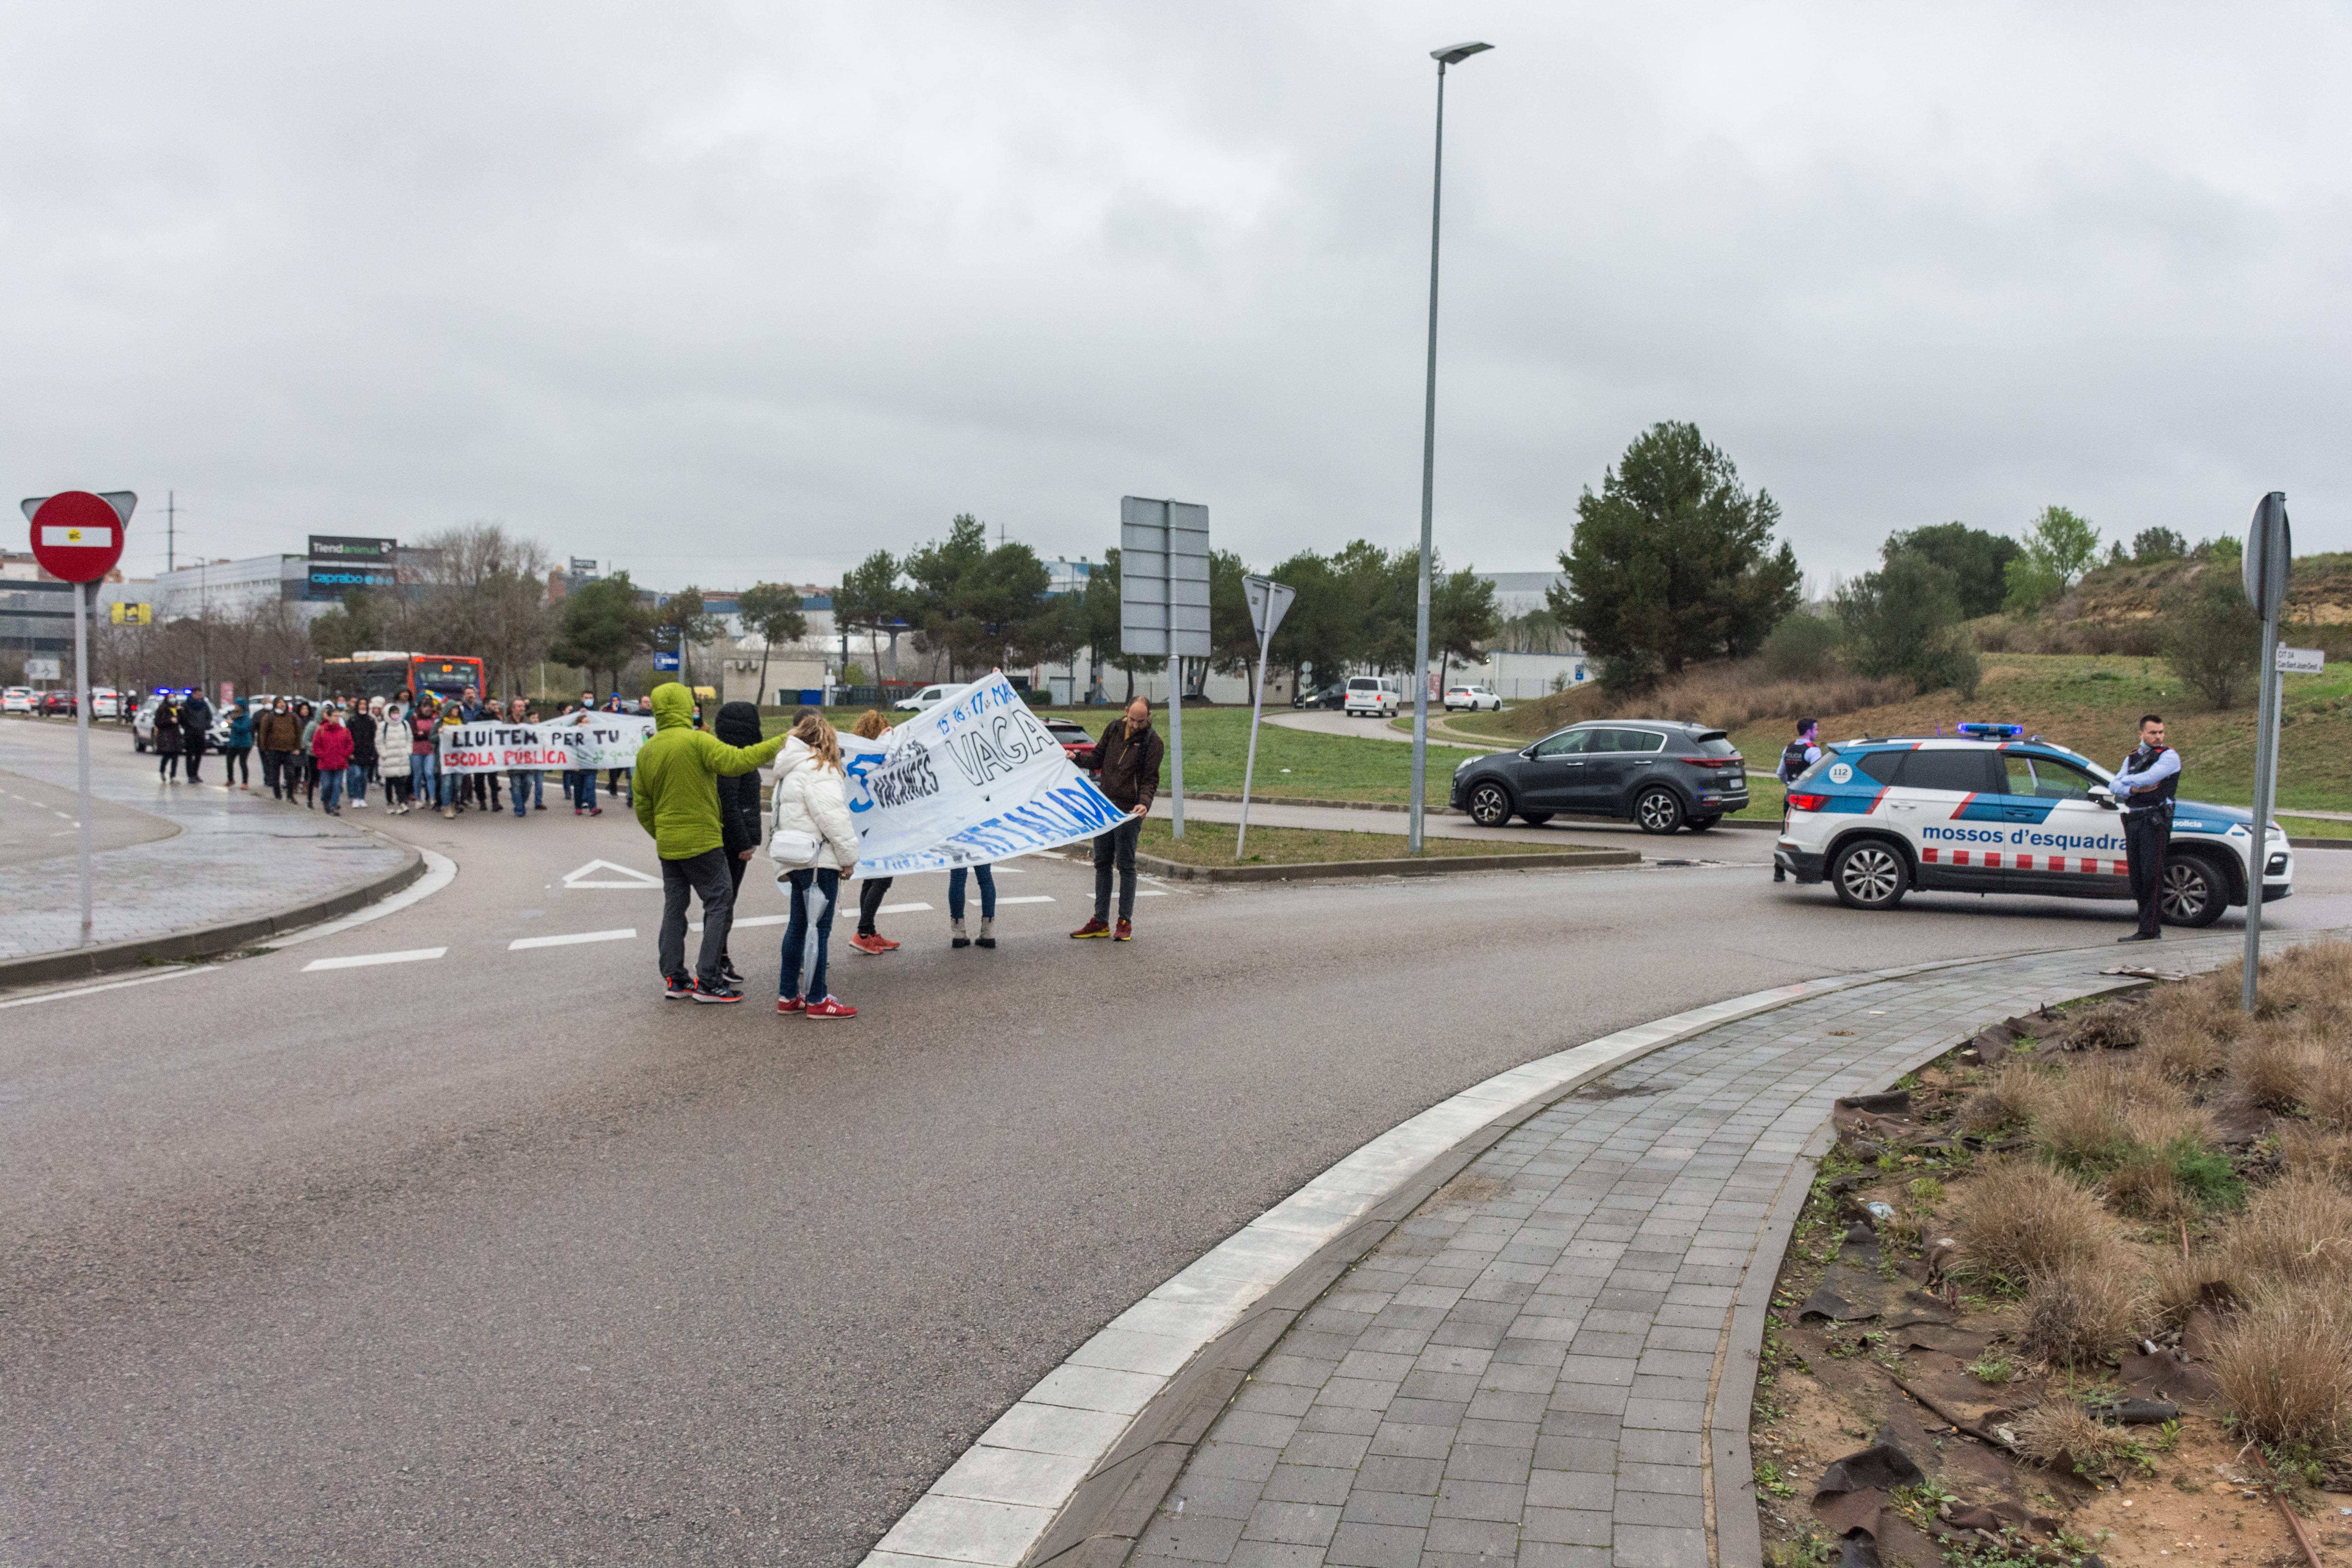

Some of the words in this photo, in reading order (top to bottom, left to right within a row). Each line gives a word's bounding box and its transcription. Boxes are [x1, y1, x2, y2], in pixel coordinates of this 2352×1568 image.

[314, 542, 379, 554] Tiendanimal
[311, 572, 363, 584] caprabo
[971, 691, 982, 714] 17
[552, 732, 585, 745] PER
[593, 730, 619, 744] TU
[444, 751, 495, 767] ESCOLA
[504, 746, 567, 766] PÚBLICA
[945, 710, 1054, 786] VAGA
[873, 754, 939, 808] VACANCES
[1923, 827, 2004, 843] mossos
